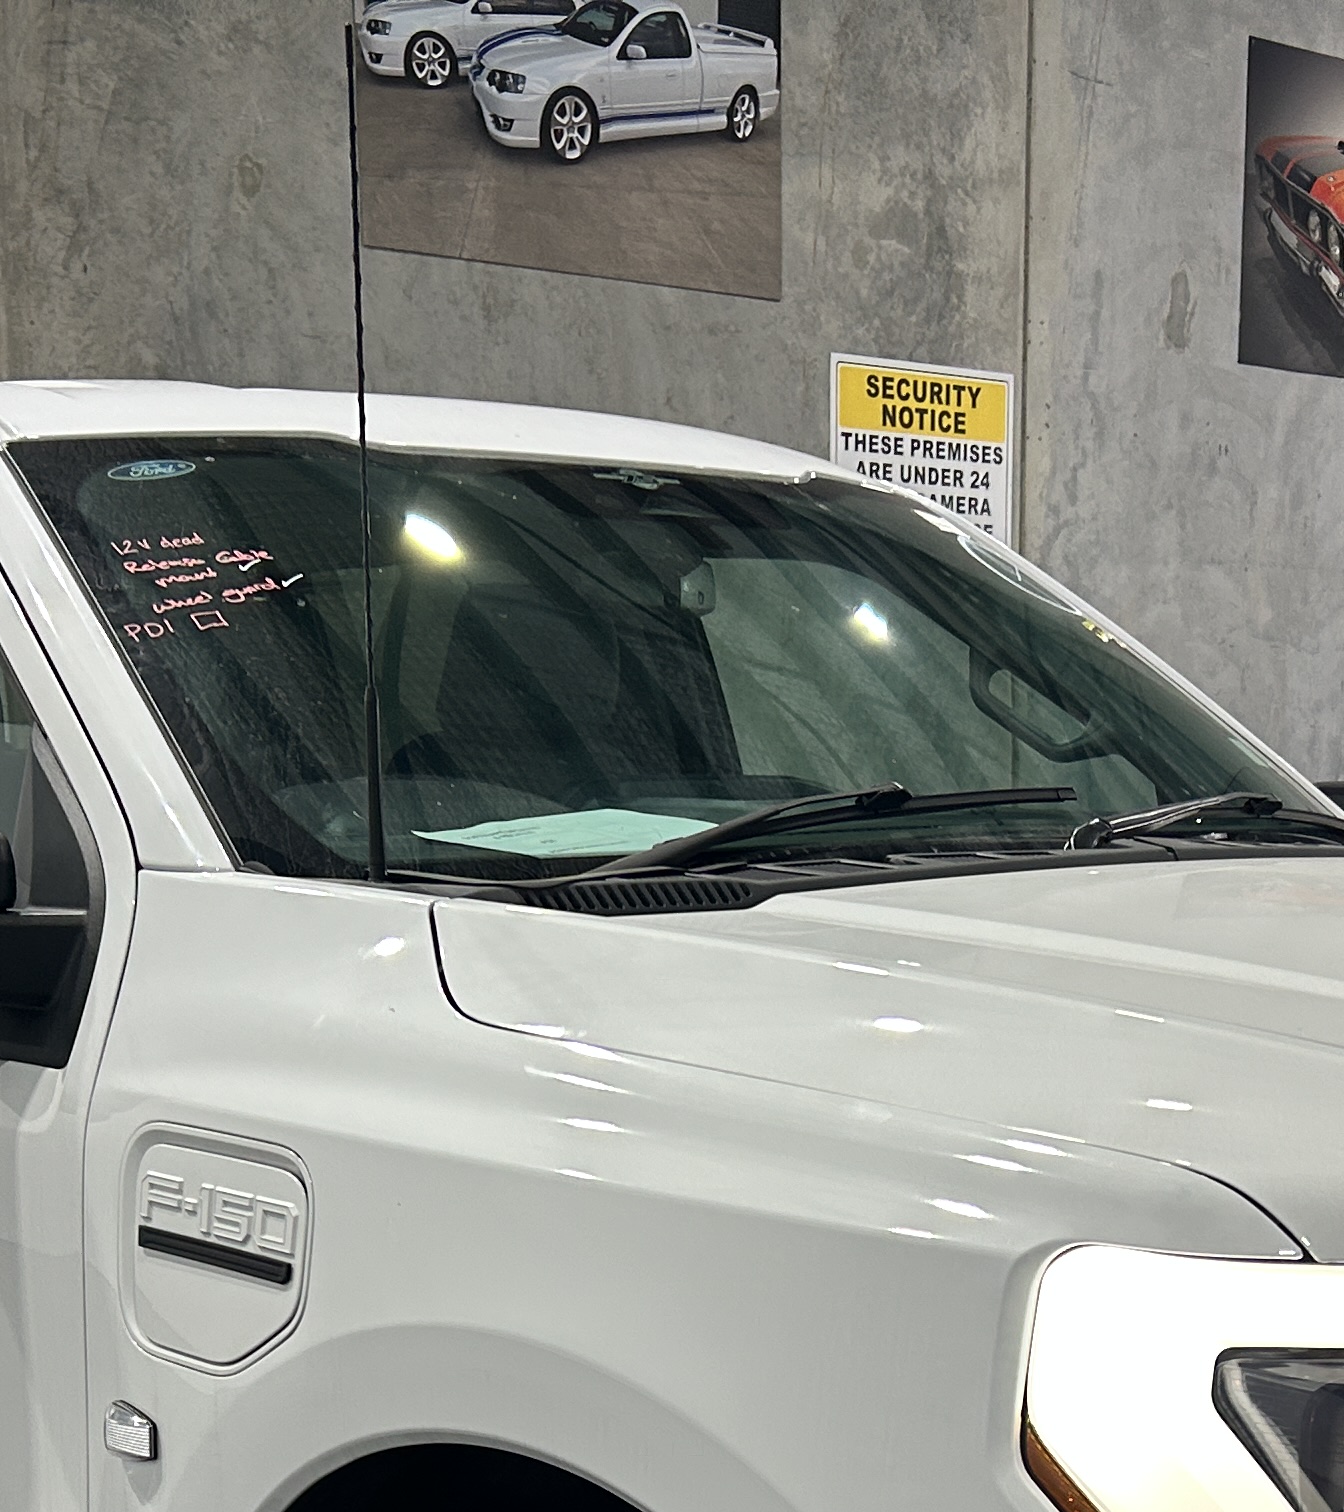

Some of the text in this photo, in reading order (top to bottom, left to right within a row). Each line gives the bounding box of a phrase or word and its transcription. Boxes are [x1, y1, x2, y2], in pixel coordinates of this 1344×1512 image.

[865, 374, 982, 409] SECURITY
[882, 404, 966, 434] NOTICE
[840, 432, 1003, 465] THESE PREMISES
[856, 460, 990, 490] ARE UNDER 24
[918, 492, 991, 517] MERA
[139, 1170, 299, 1259] F-150
